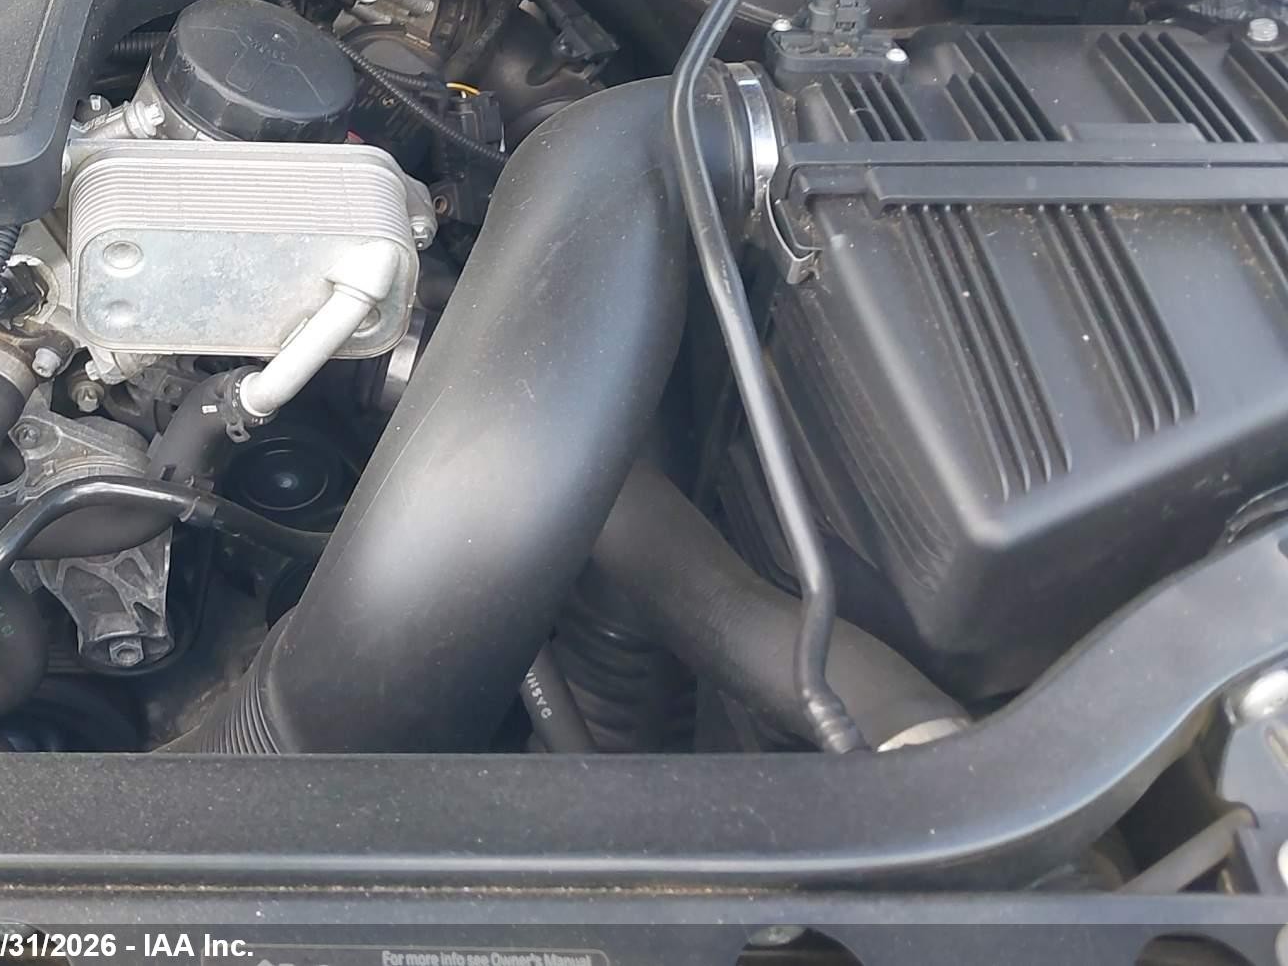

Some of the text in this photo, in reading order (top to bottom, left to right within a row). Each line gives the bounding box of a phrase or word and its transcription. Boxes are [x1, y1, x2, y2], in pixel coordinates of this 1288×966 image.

[382, 950, 592, 966] For more info see Owner's Manual
